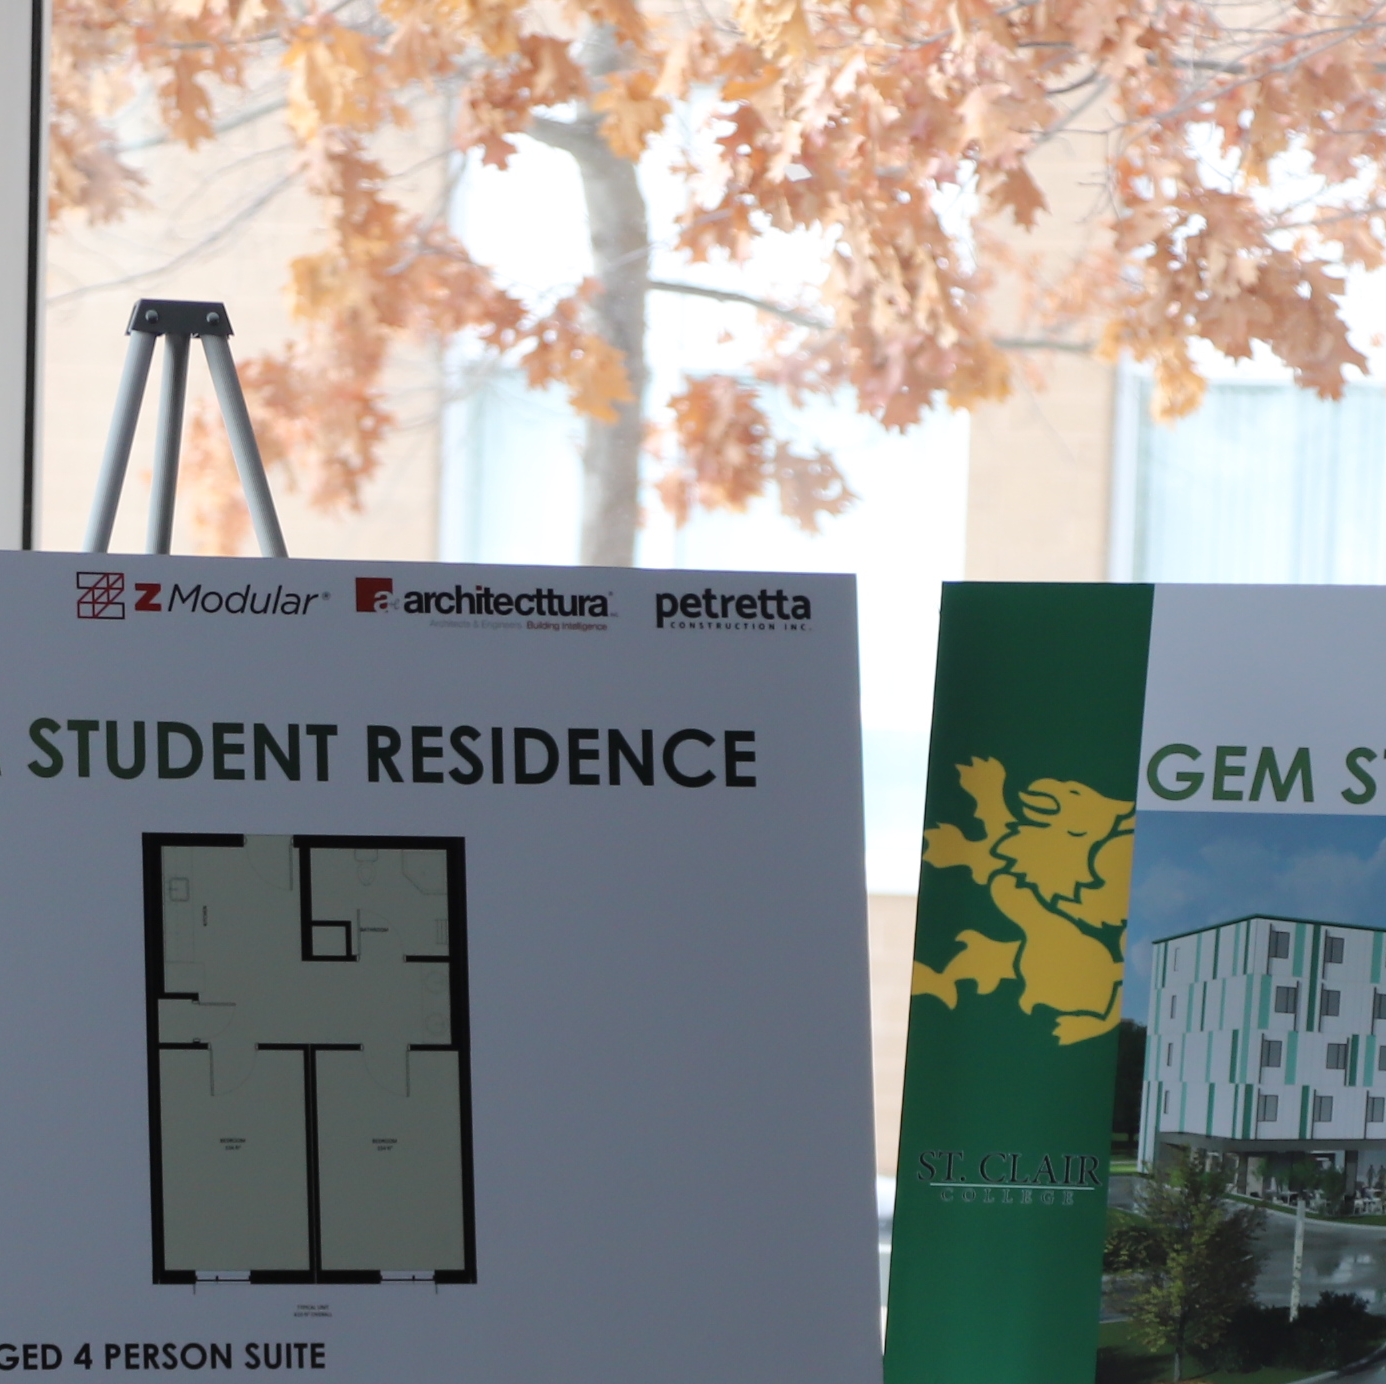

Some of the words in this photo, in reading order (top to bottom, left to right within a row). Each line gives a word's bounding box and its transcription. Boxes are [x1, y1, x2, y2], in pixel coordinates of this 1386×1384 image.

[167, 584, 319, 615] Modular
[404, 584, 609, 617] architecttura
[656, 588, 811, 628] petretta
[527, 621, 560, 631] Building
[563, 622, 608, 632] Intelligence
[670, 621, 775, 630] CONSTRUCTION
[784, 623, 812, 631] INC.
[27, 717, 338, 782] STUDENT
[367, 724, 757, 788] RESIDENCE
[1146, 742, 1314, 803] GEM
[918, 1151, 966, 1181] ST.
[979, 1152, 1102, 1185] CLAIR
[941, 1188, 1075, 1205] COLLEGE
[73, 1343, 93, 1370] 4
[104, 1342, 233, 1370] PERSON
[244, 1342, 326, 1370] SUITE
